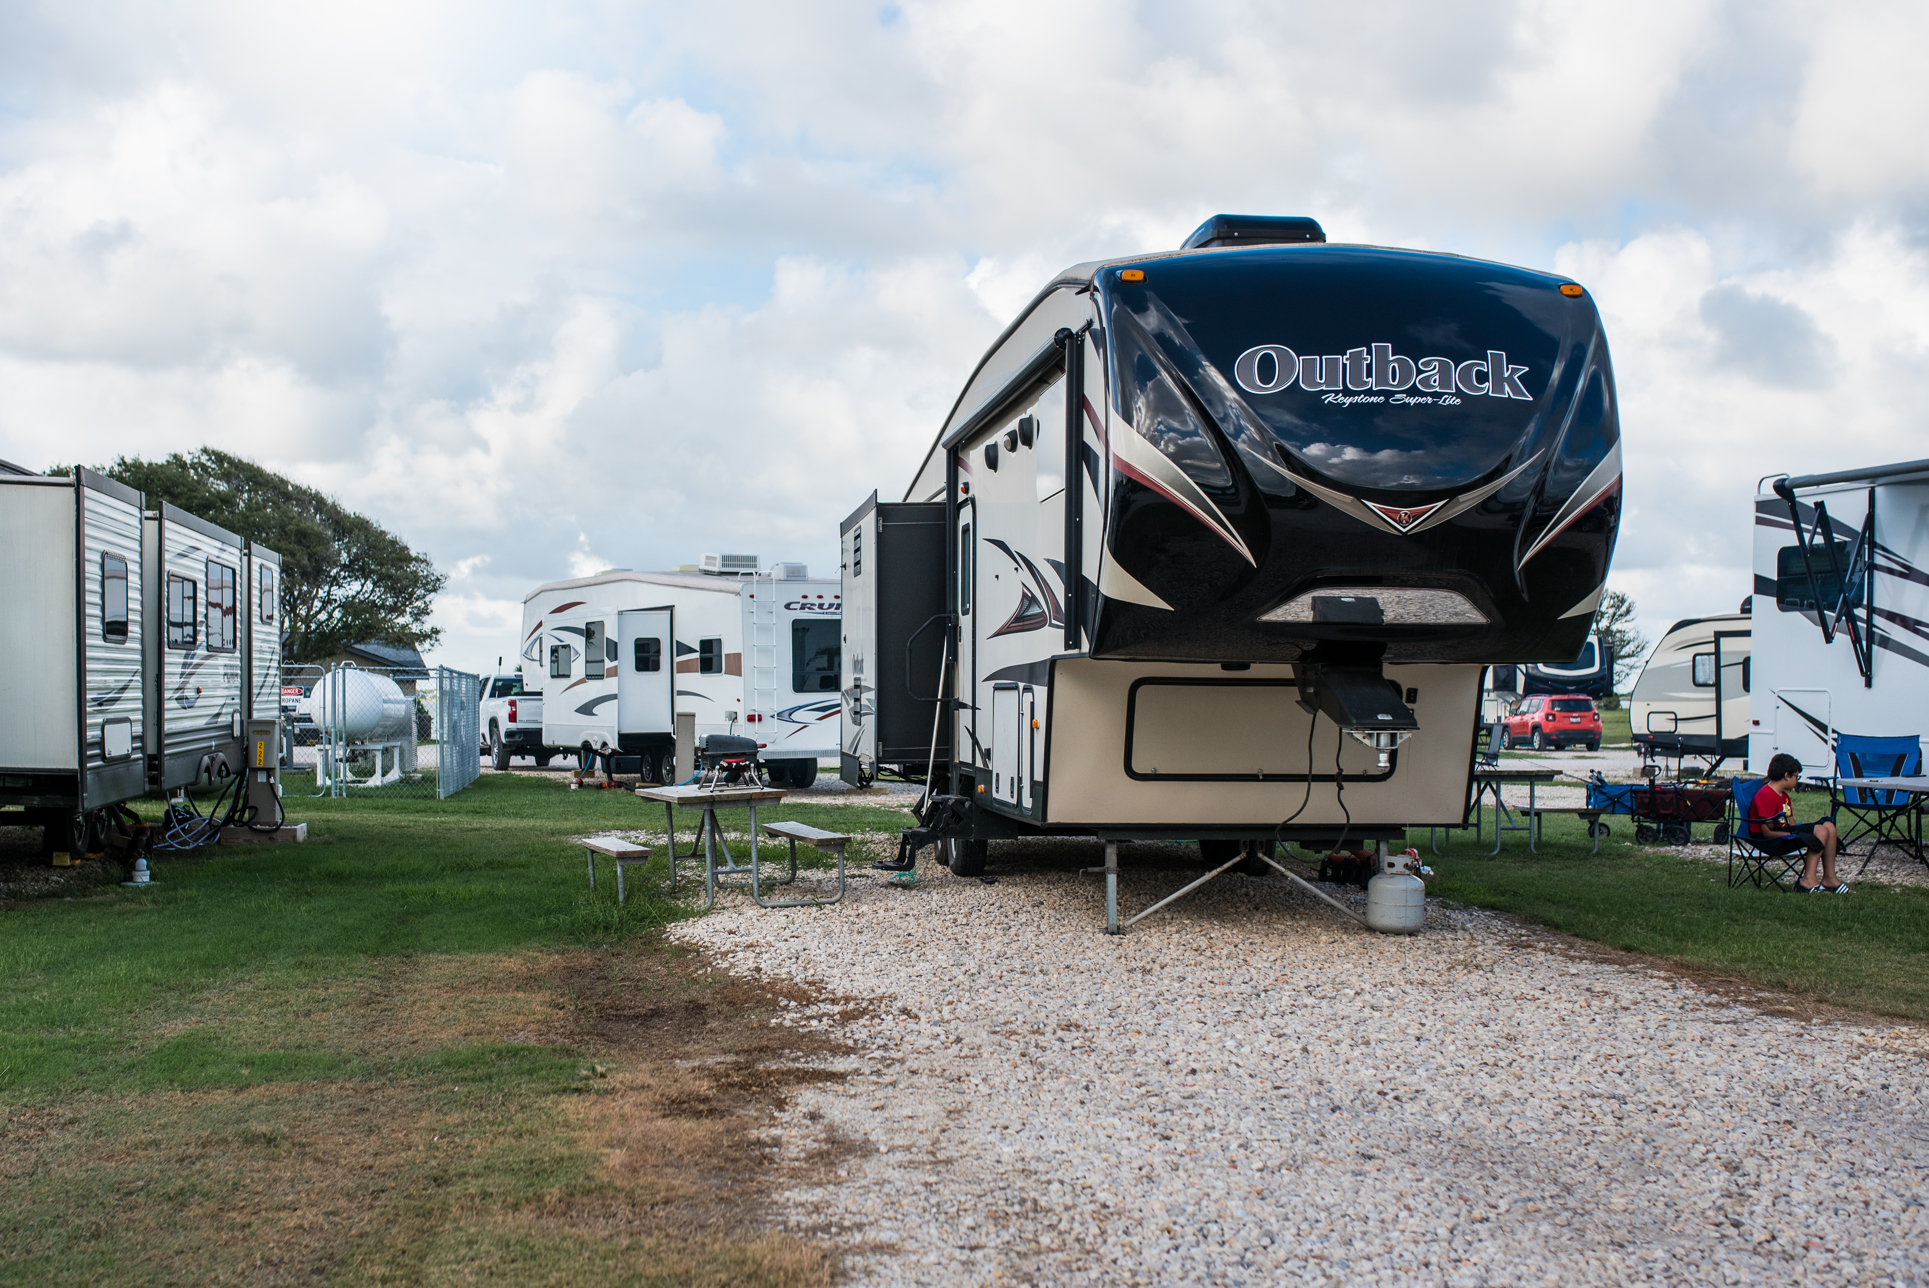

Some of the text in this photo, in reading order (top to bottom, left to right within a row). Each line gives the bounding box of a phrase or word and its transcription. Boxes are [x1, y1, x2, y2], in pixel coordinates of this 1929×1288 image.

[1234, 343, 1533, 401] Outback
[1321, 393, 1461, 408] Keystone Super-Lite
